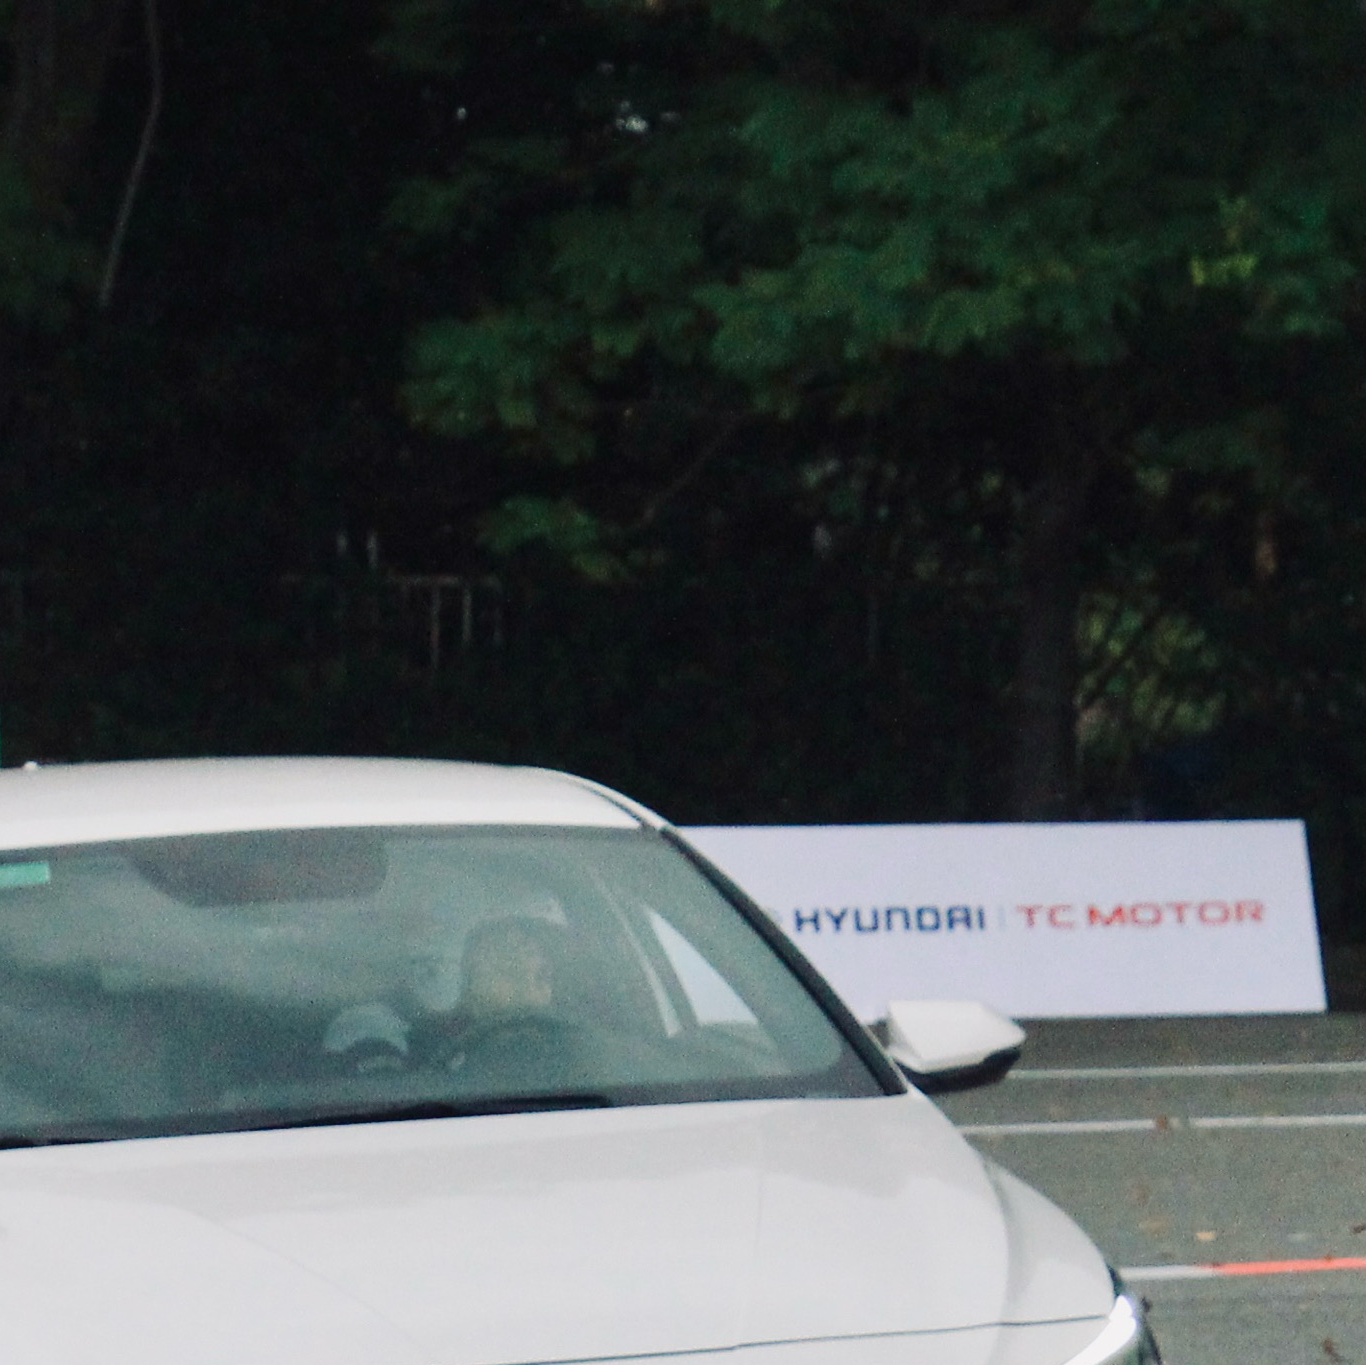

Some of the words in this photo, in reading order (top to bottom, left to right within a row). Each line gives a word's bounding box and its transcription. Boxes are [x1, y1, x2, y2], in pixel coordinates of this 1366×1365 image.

[794, 904, 986, 933] HYUNDAI
[1016, 903, 1075, 930] TC
[1087, 898, 1265, 929] MOTOR
